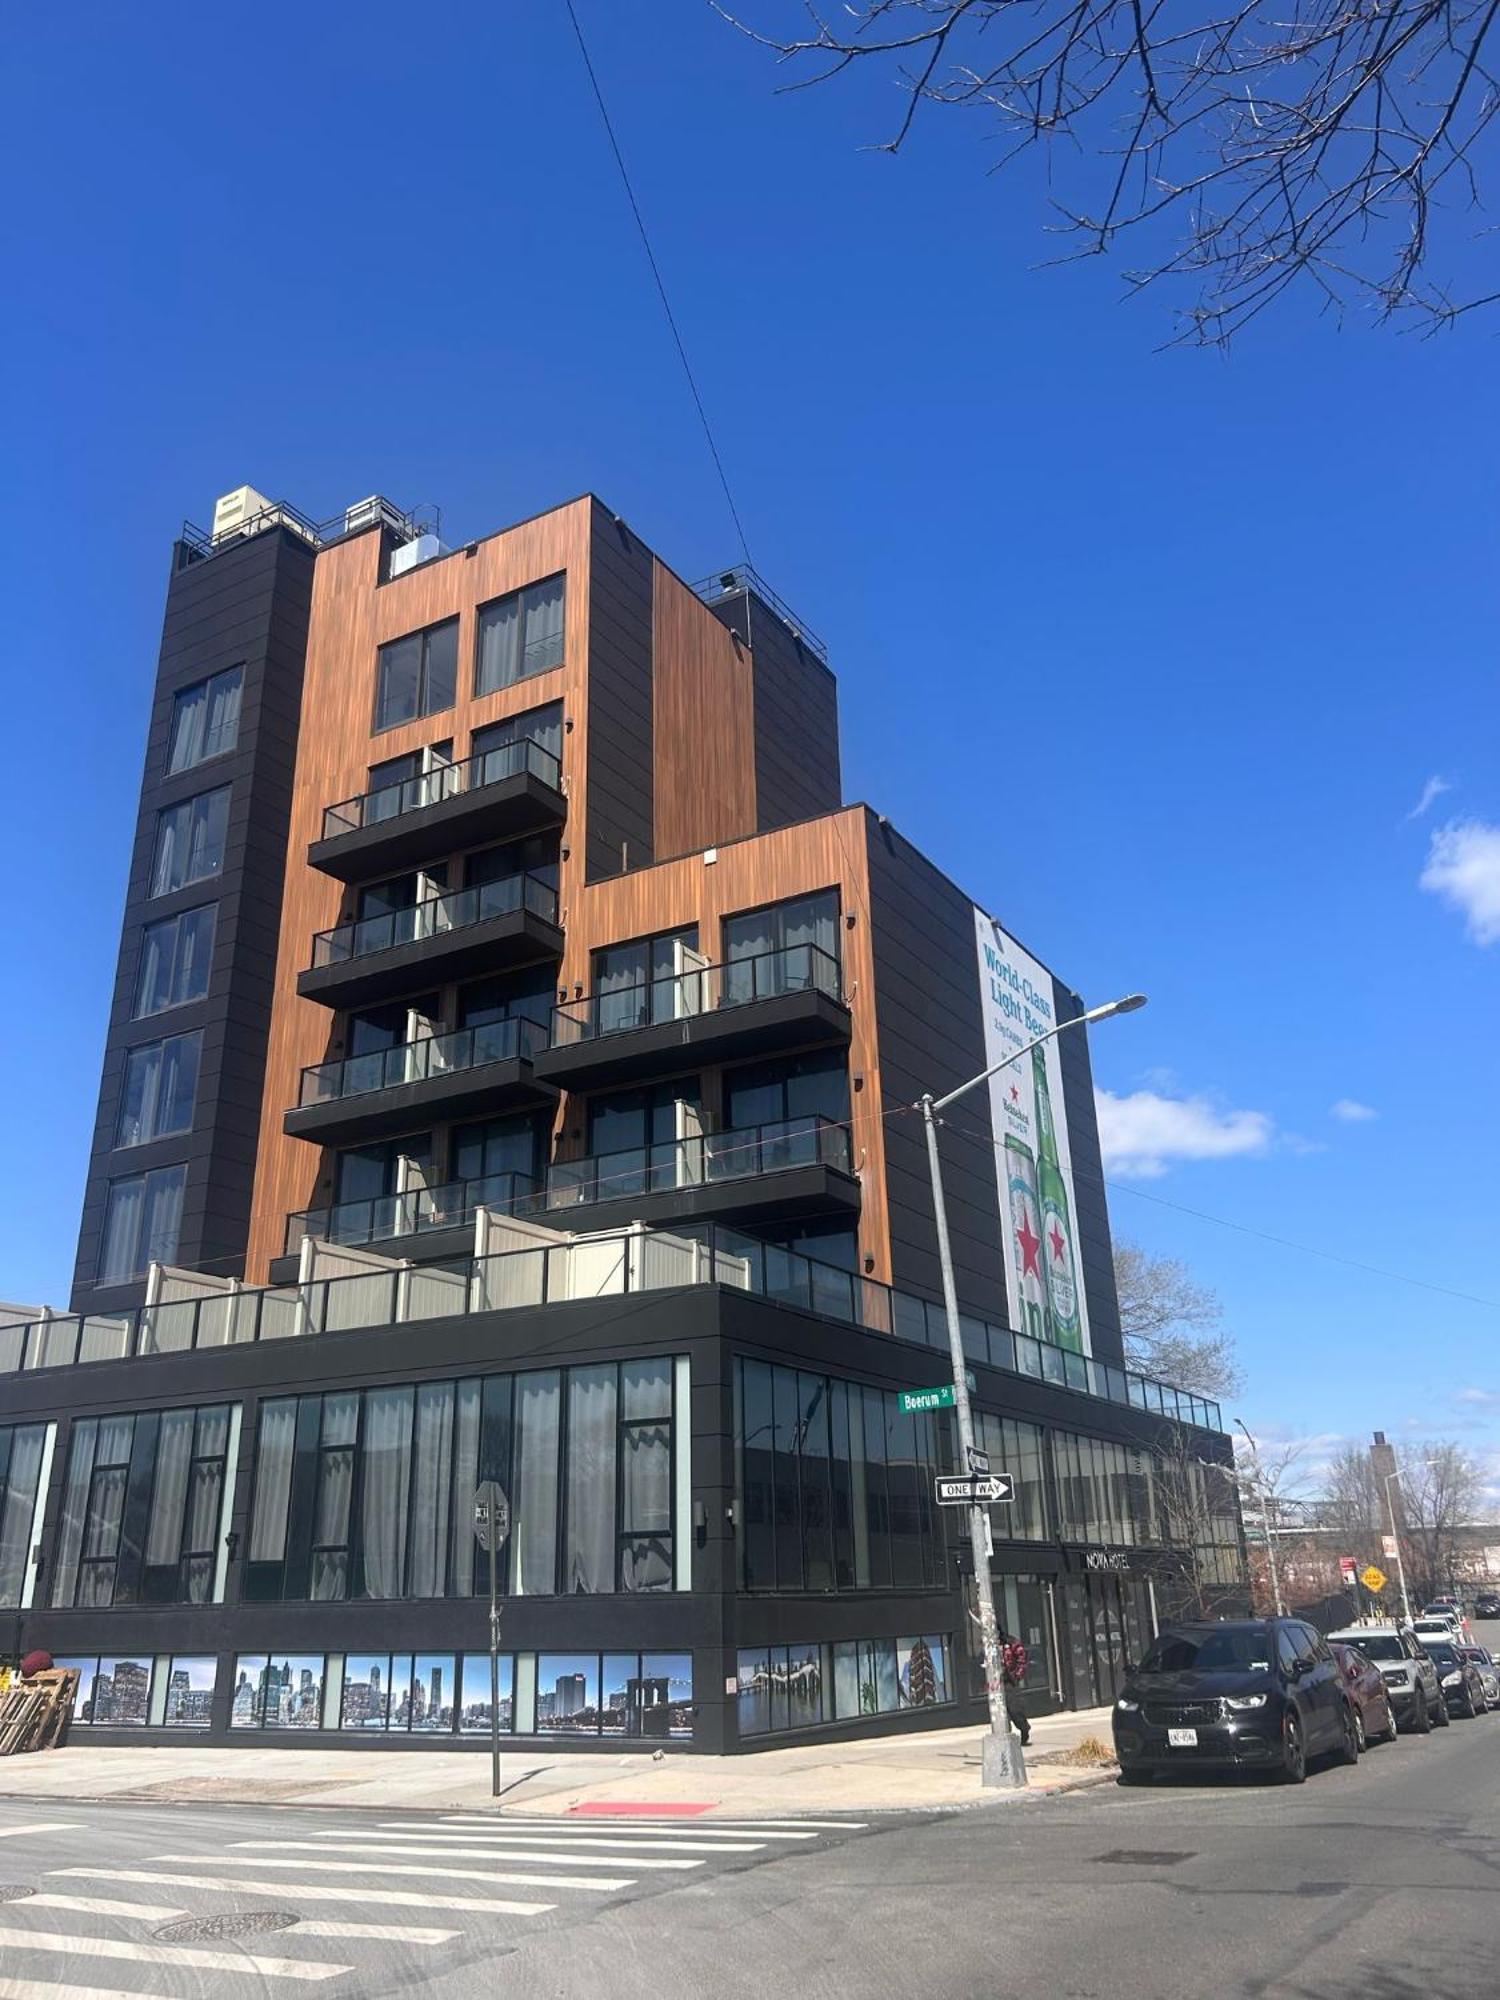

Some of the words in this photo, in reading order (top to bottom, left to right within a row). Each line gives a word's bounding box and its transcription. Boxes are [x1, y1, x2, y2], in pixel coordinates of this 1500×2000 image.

[984, 943, 1051, 1018] World-Class
[991, 978, 1022, 1020] Light
[904, 1393, 940, 1410] Boerum
[941, 1388, 949, 1398] St
[947, 1485, 969, 1496] ONE
[979, 1483, 1001, 1494] WAY
[1109, 1553, 1131, 1569] HOTEL
